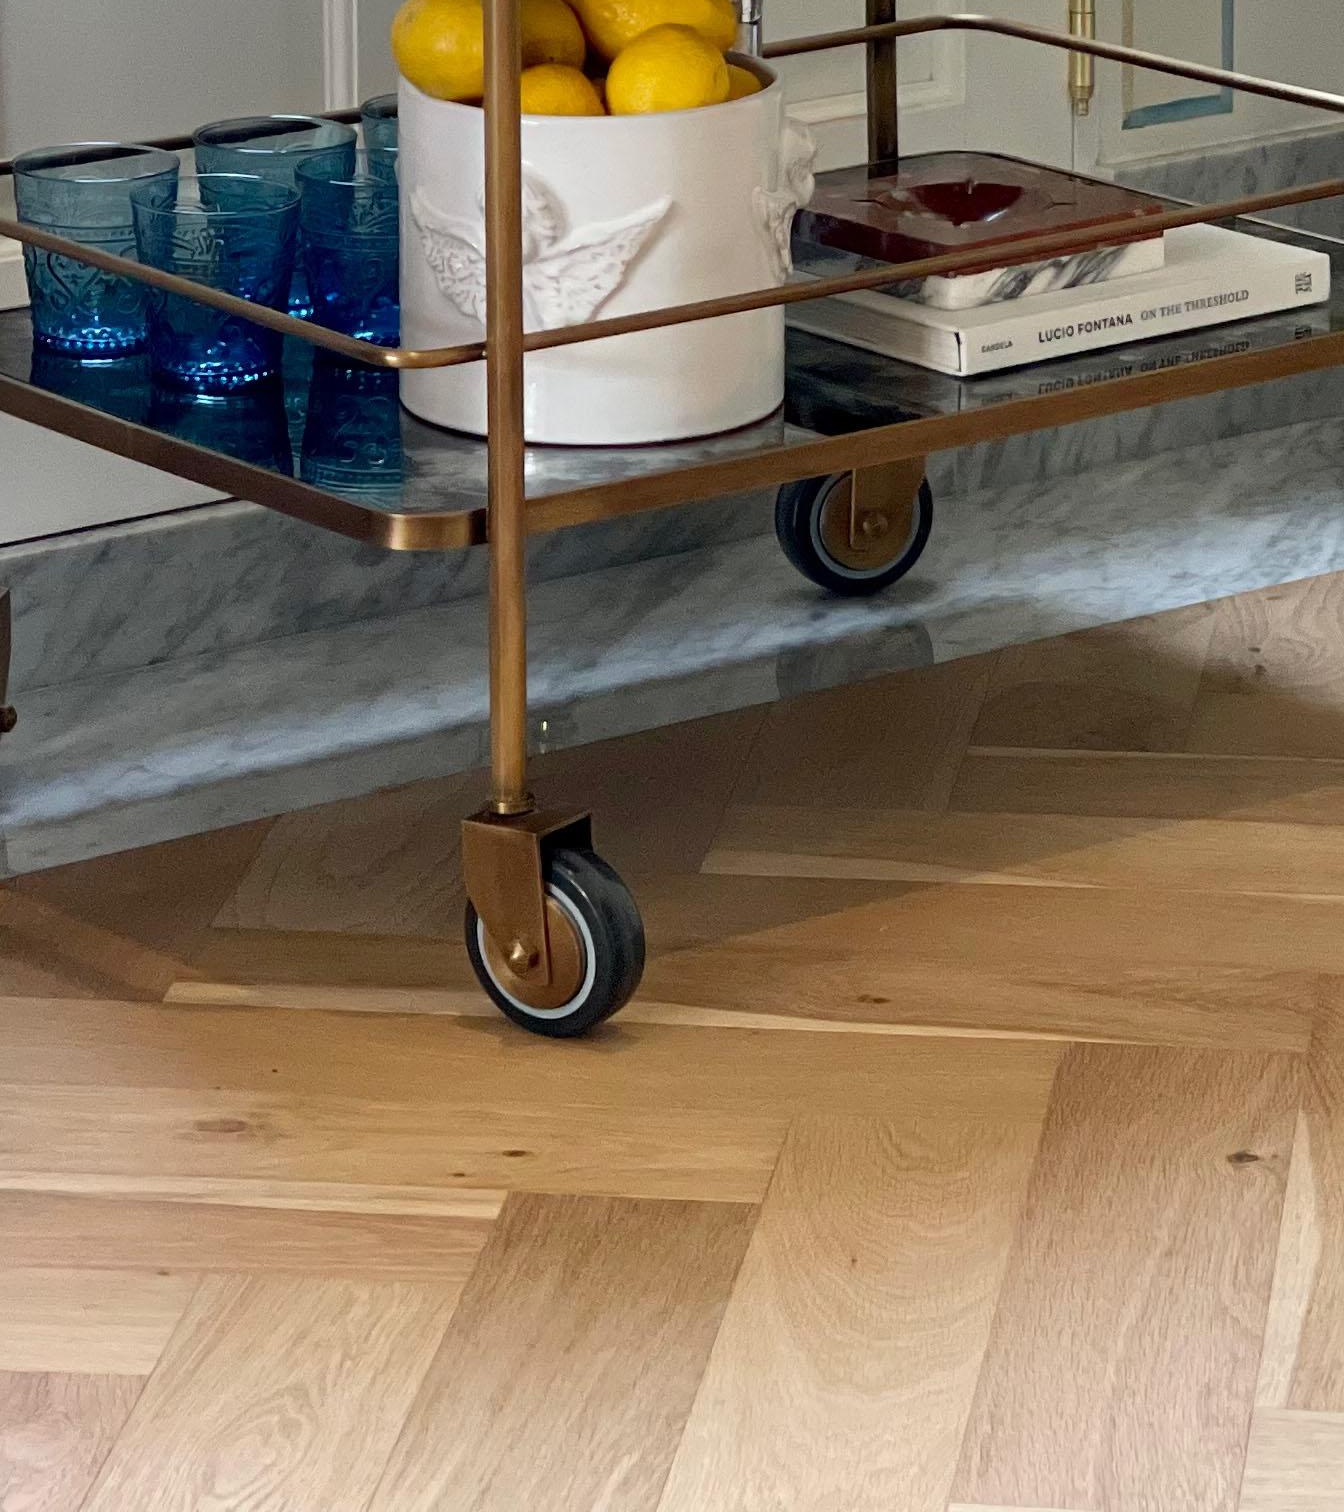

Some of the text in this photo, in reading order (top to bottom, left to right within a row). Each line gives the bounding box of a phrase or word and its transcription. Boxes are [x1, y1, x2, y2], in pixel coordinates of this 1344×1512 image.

[1038, 289, 1250, 343] LUCIO FONTANA ON THE THRESHOLD
